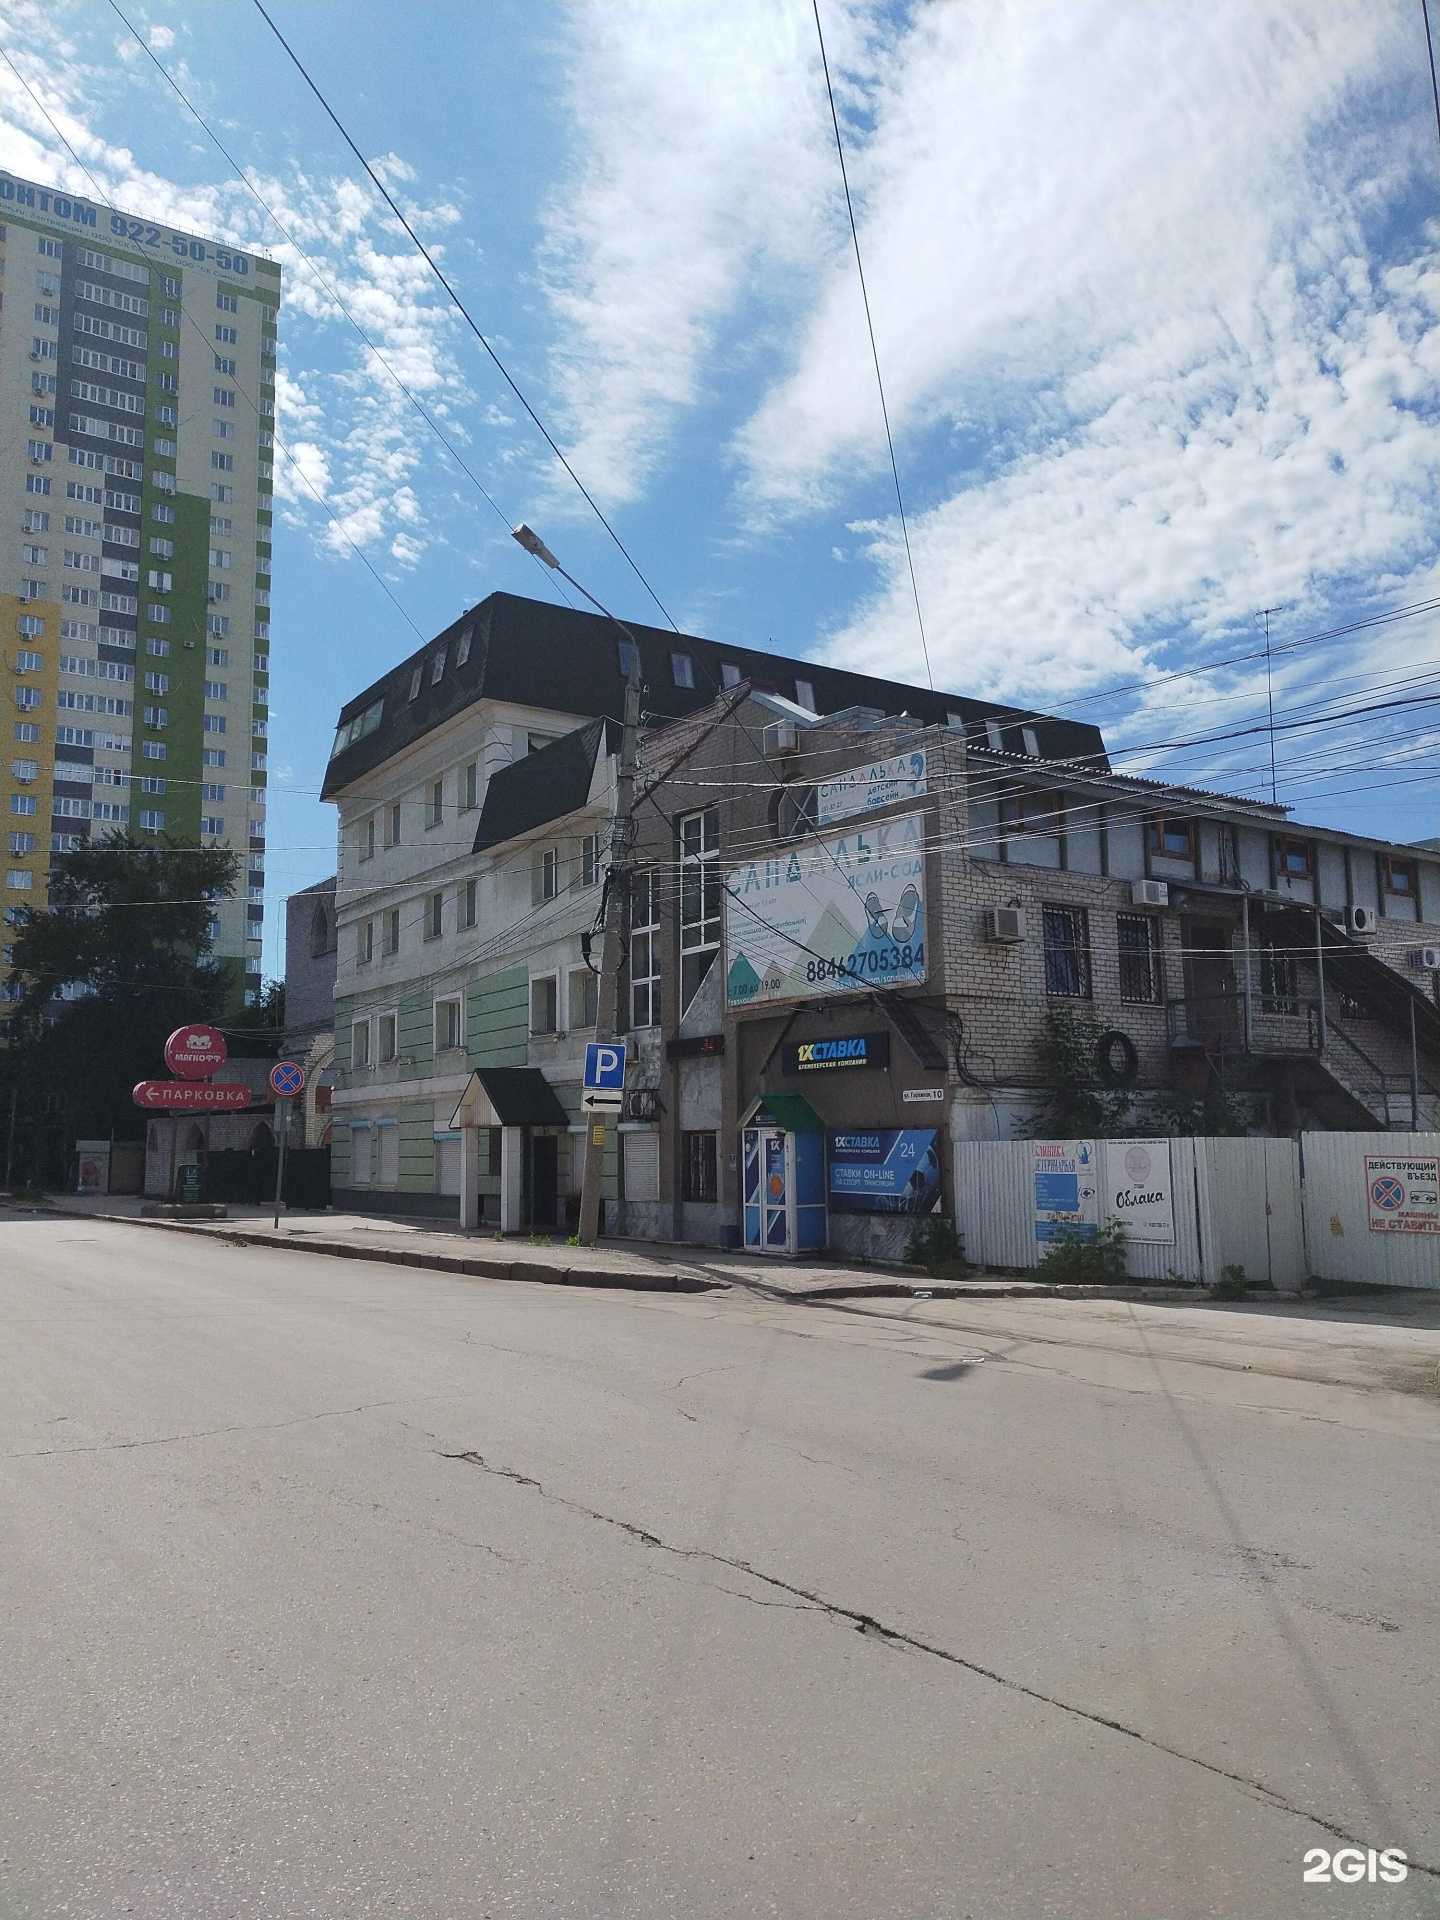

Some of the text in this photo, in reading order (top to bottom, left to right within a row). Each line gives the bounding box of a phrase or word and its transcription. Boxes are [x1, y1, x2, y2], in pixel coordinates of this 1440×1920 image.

[110, 214, 248, 275] 922-50-50
[806, 943, 925, 983] 88462705384
[163, 1090, 245, 1101] ПАРКОВКА
[933, 1090, 942, 1099] 10
[901, 1143, 916, 1158] 24
[1368, 1160, 1436, 1171] ДЕЙСТВУЮЩИЙ
[863, 1169, 895, 1180] ON-LINE
[1408, 1172, 1437, 1182] ВЪЕЗД
[1116, 1190, 1165, 1208] Облака
[1371, 1218, 1385, 1229] НЕ
